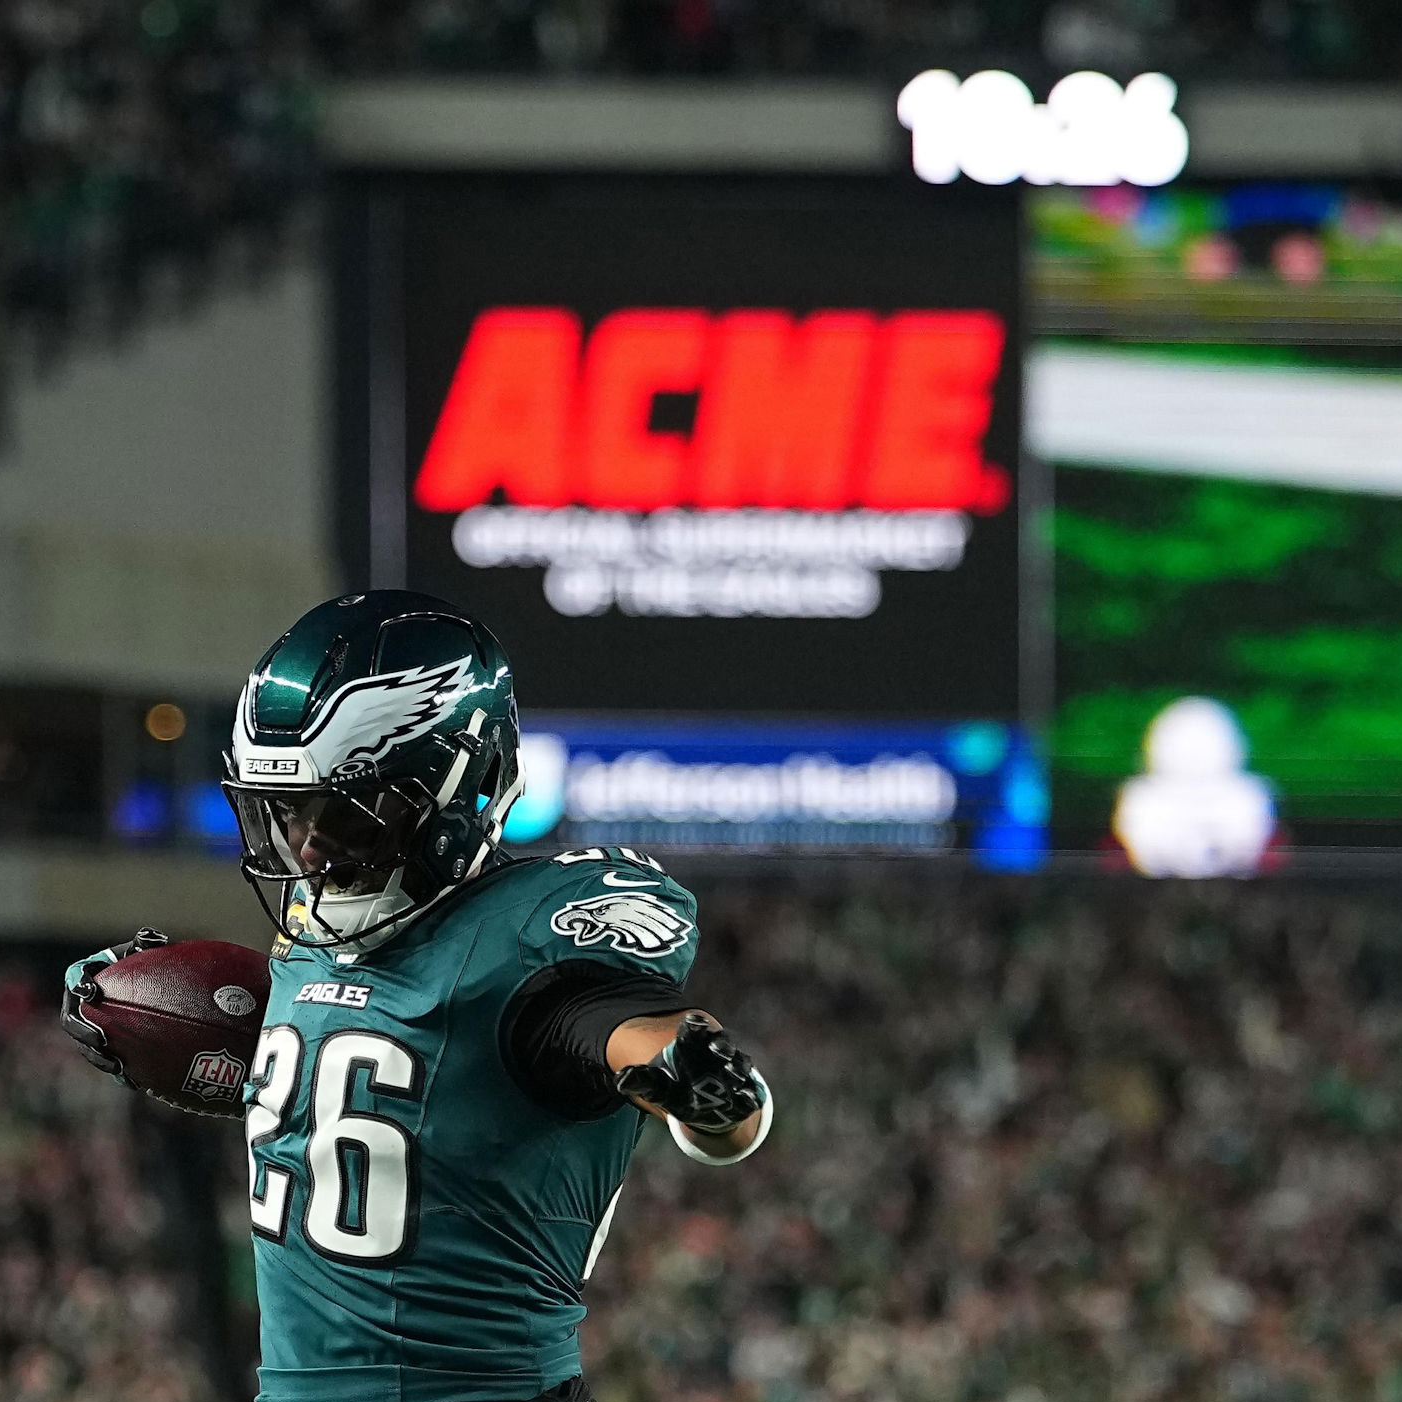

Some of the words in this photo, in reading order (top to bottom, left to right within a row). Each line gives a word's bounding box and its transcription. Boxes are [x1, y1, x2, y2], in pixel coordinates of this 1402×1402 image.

[247, 760, 297, 774] EAGLES
[331, 768, 375, 783] OAKLEY
[294, 983, 371, 1008] EAGLES
[198, 1057, 239, 1087] NFL
[247, 1024, 424, 1268] 26
